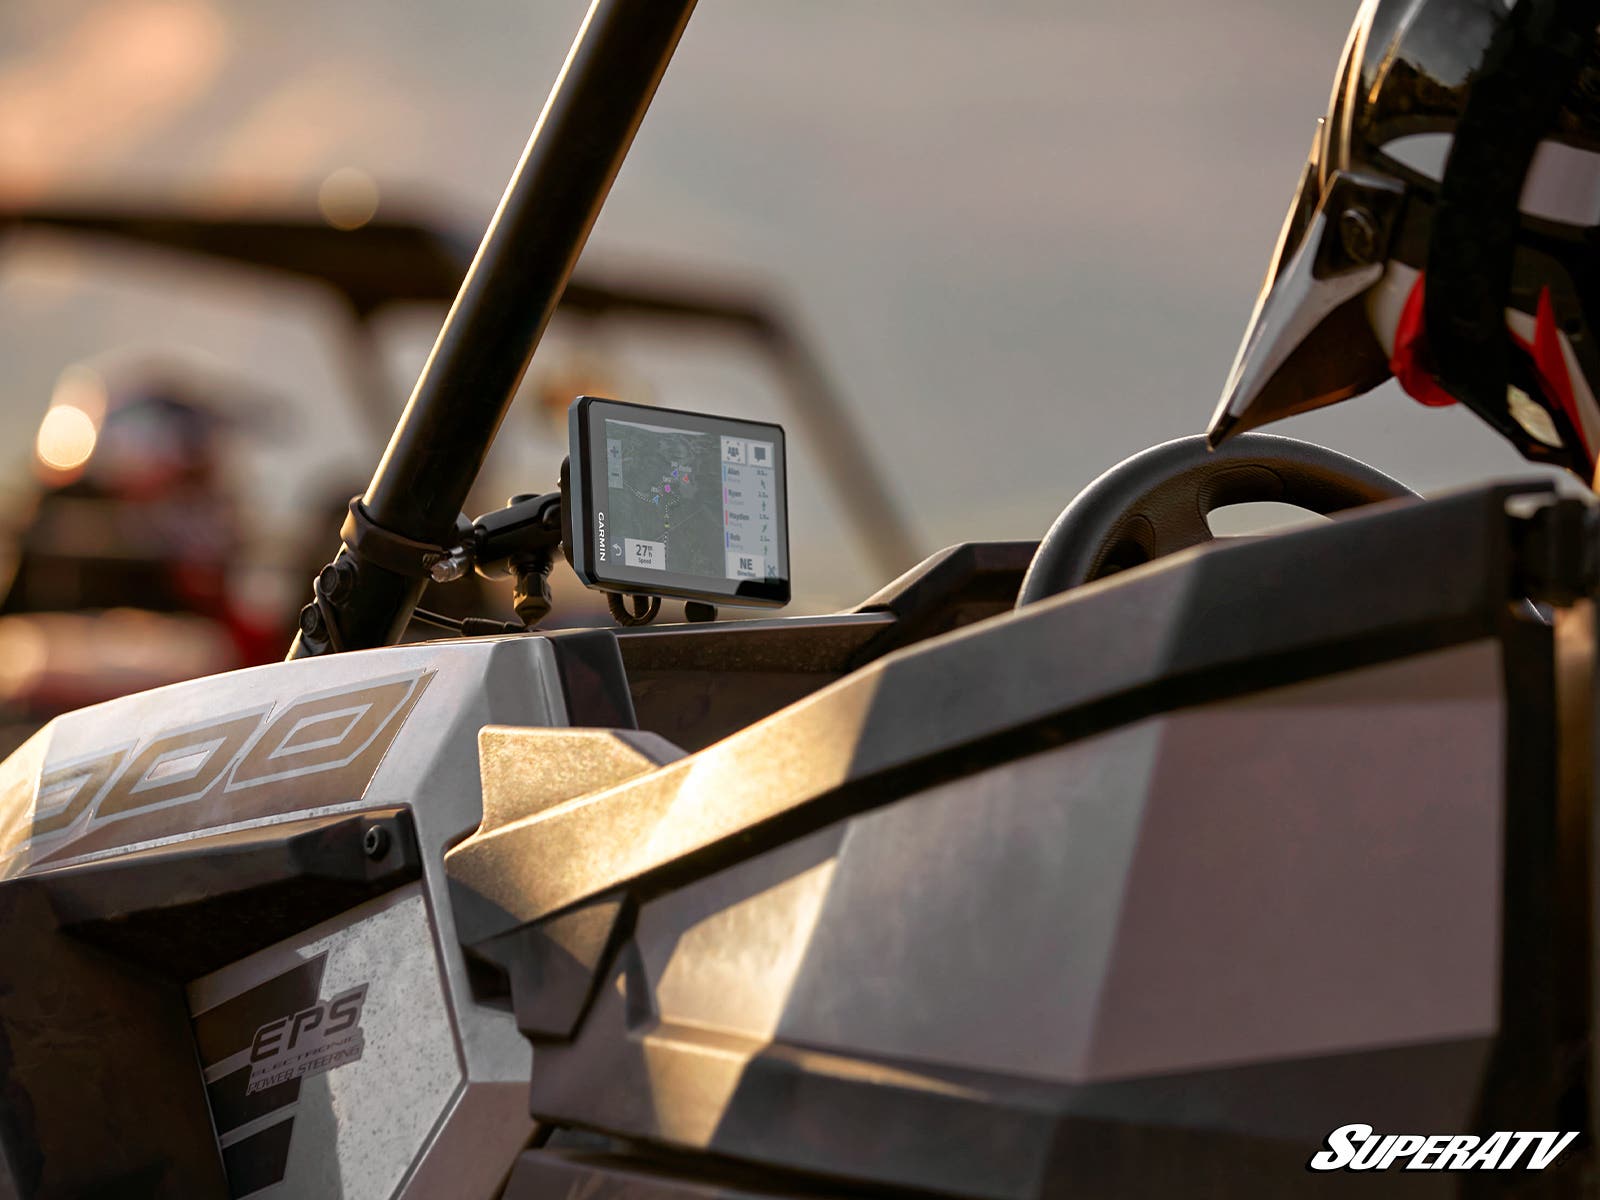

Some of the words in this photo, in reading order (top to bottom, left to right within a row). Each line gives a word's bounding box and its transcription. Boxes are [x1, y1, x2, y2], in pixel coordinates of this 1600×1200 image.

[598, 511, 606, 562] GARMIN
[635, 544, 647, 557] 27
[739, 558, 753, 570] NE
[250, 991, 363, 1063] EPS
[248, 1068, 294, 1092] POWER
[298, 1046, 361, 1074] STEERING
[252, 1036, 353, 1078] ELECTRONIC
